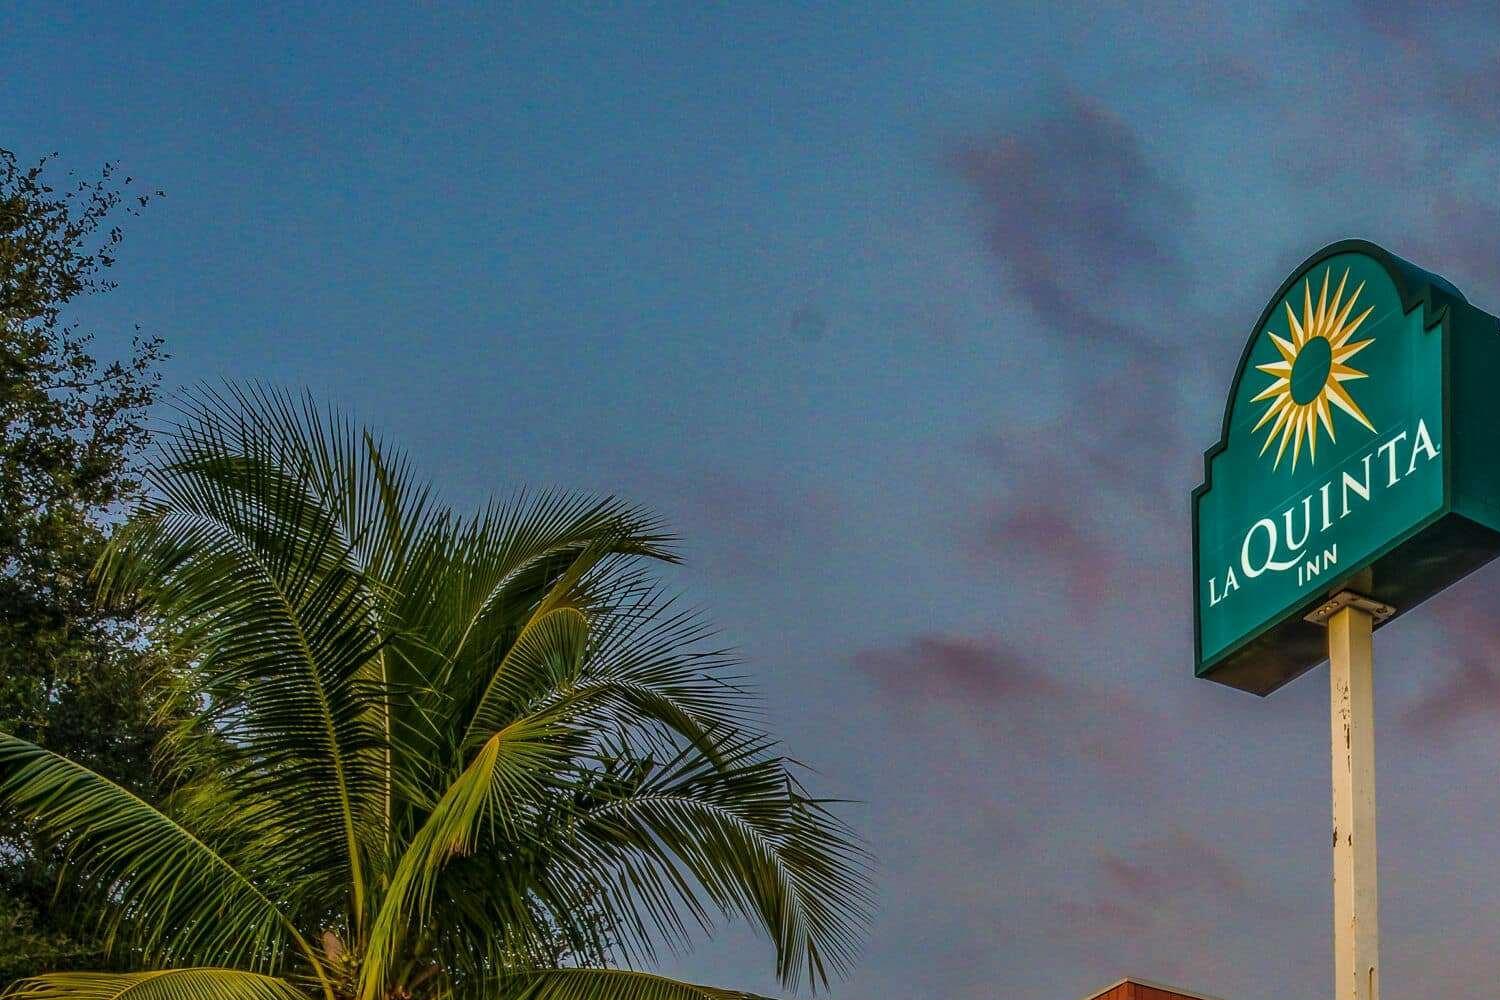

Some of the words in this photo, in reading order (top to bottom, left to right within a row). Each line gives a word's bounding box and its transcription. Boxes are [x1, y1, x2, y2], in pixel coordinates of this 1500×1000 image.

[1208, 567, 1240, 607] LA
[1240, 418, 1440, 578] QUINTA
[1297, 543, 1338, 587] INN
